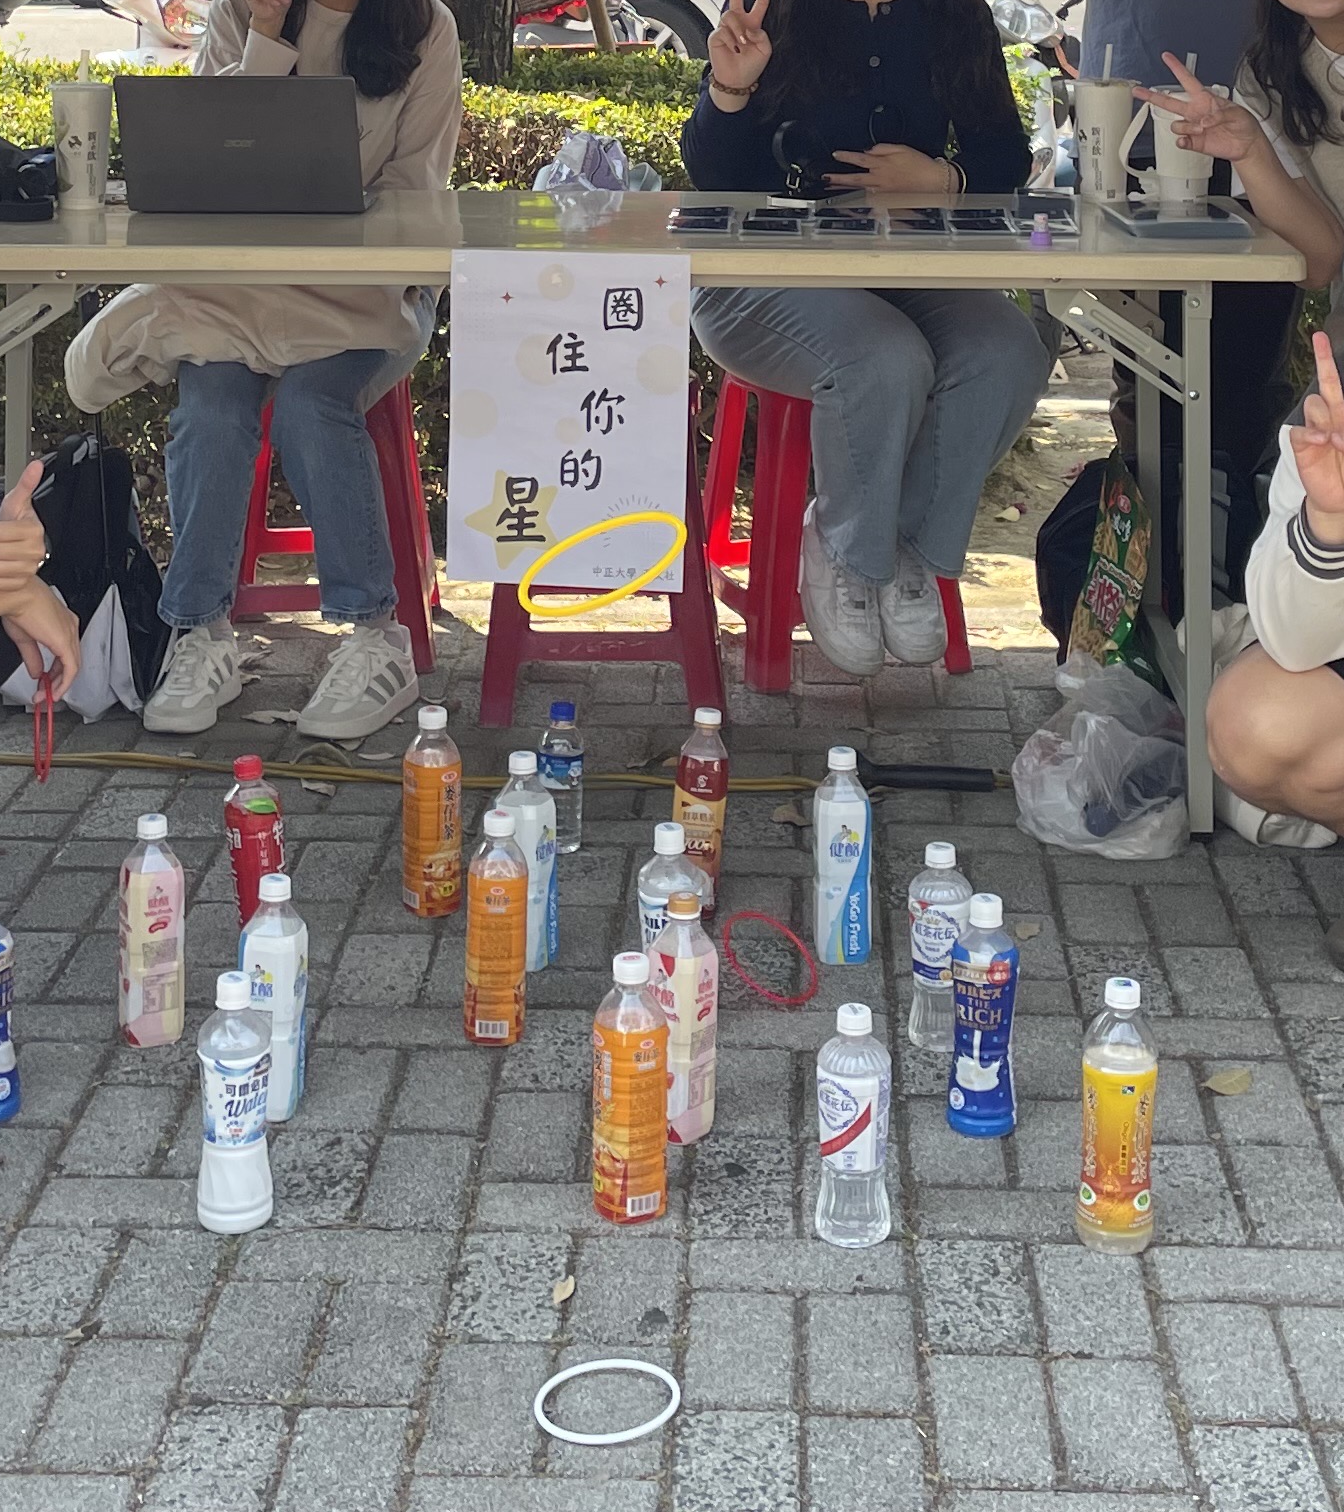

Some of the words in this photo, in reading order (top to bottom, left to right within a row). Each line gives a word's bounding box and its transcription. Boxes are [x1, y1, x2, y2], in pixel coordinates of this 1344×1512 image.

[914, 923, 957, 941] 紅茶花伝
[967, 997, 991, 1009] THE
[956, 1004, 1002, 1026] RICH
